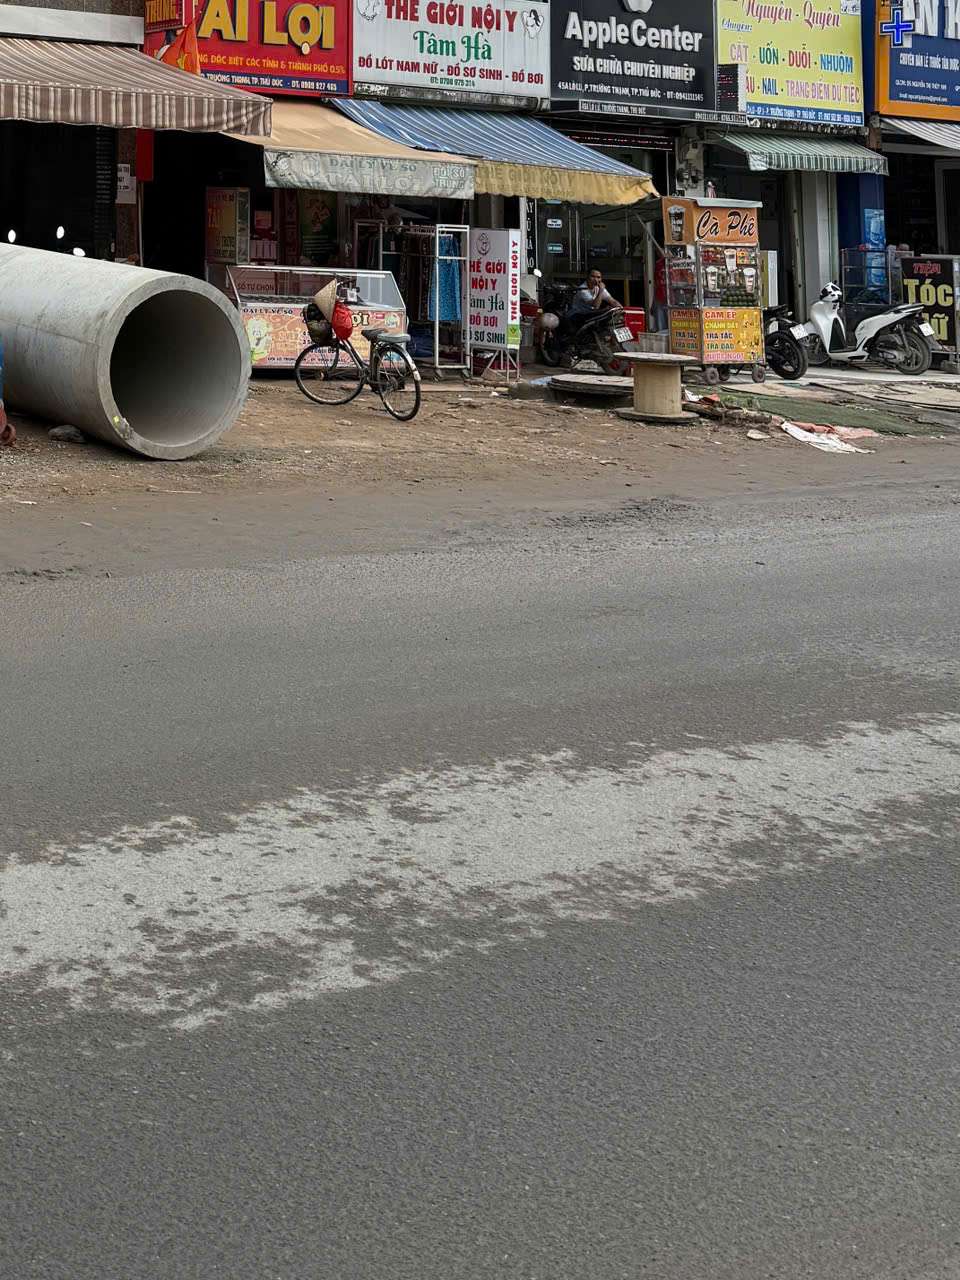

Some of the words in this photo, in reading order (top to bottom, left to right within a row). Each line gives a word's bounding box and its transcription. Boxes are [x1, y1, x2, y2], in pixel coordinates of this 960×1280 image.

[261, 0, 335, 55] LỢI
[426, 0, 464, 27] GIỚI
[471, 3, 501, 33] NỘI
[505, 10, 517, 32] Y
[413, 30, 456, 57] Tâm
[461, 31, 492, 63] Hà
[280, 61, 286, 69] &
[573, 54, 594, 72] SỬA
[595, 55, 623, 75] CHỮA
[624, 59, 661, 79] CHUYÊN
[662, 64, 696, 84] NGHIỆP
[759, 41, 779, 65] UỐN
[820, 50, 854, 75] NHUỘM
[375, 56, 393, 70] LÓT
[397, 60, 420, 73] NAM
[423, 61, 439, 75] NỮ
[463, 66, 477, 78] SƠ
[479, 67, 502, 81] SINH
[528, 73, 544, 85] BƠI
[762, 77, 778, 95] NAIL
[786, 79, 809, 99] TRANG
[696, 210, 719, 239] Cà
[727, 210, 755, 237] Phê
[485, 260, 506, 274] GIỚI
[471, 276, 488, 290] NỘI
[490, 278, 498, 290] Y
[488, 293, 505, 312] Hà
[483, 315, 498, 327] BƠI
[705, 311, 724, 319] CAM
[474, 330, 485, 342] SƠ
[487, 331, 505, 344] SINH
